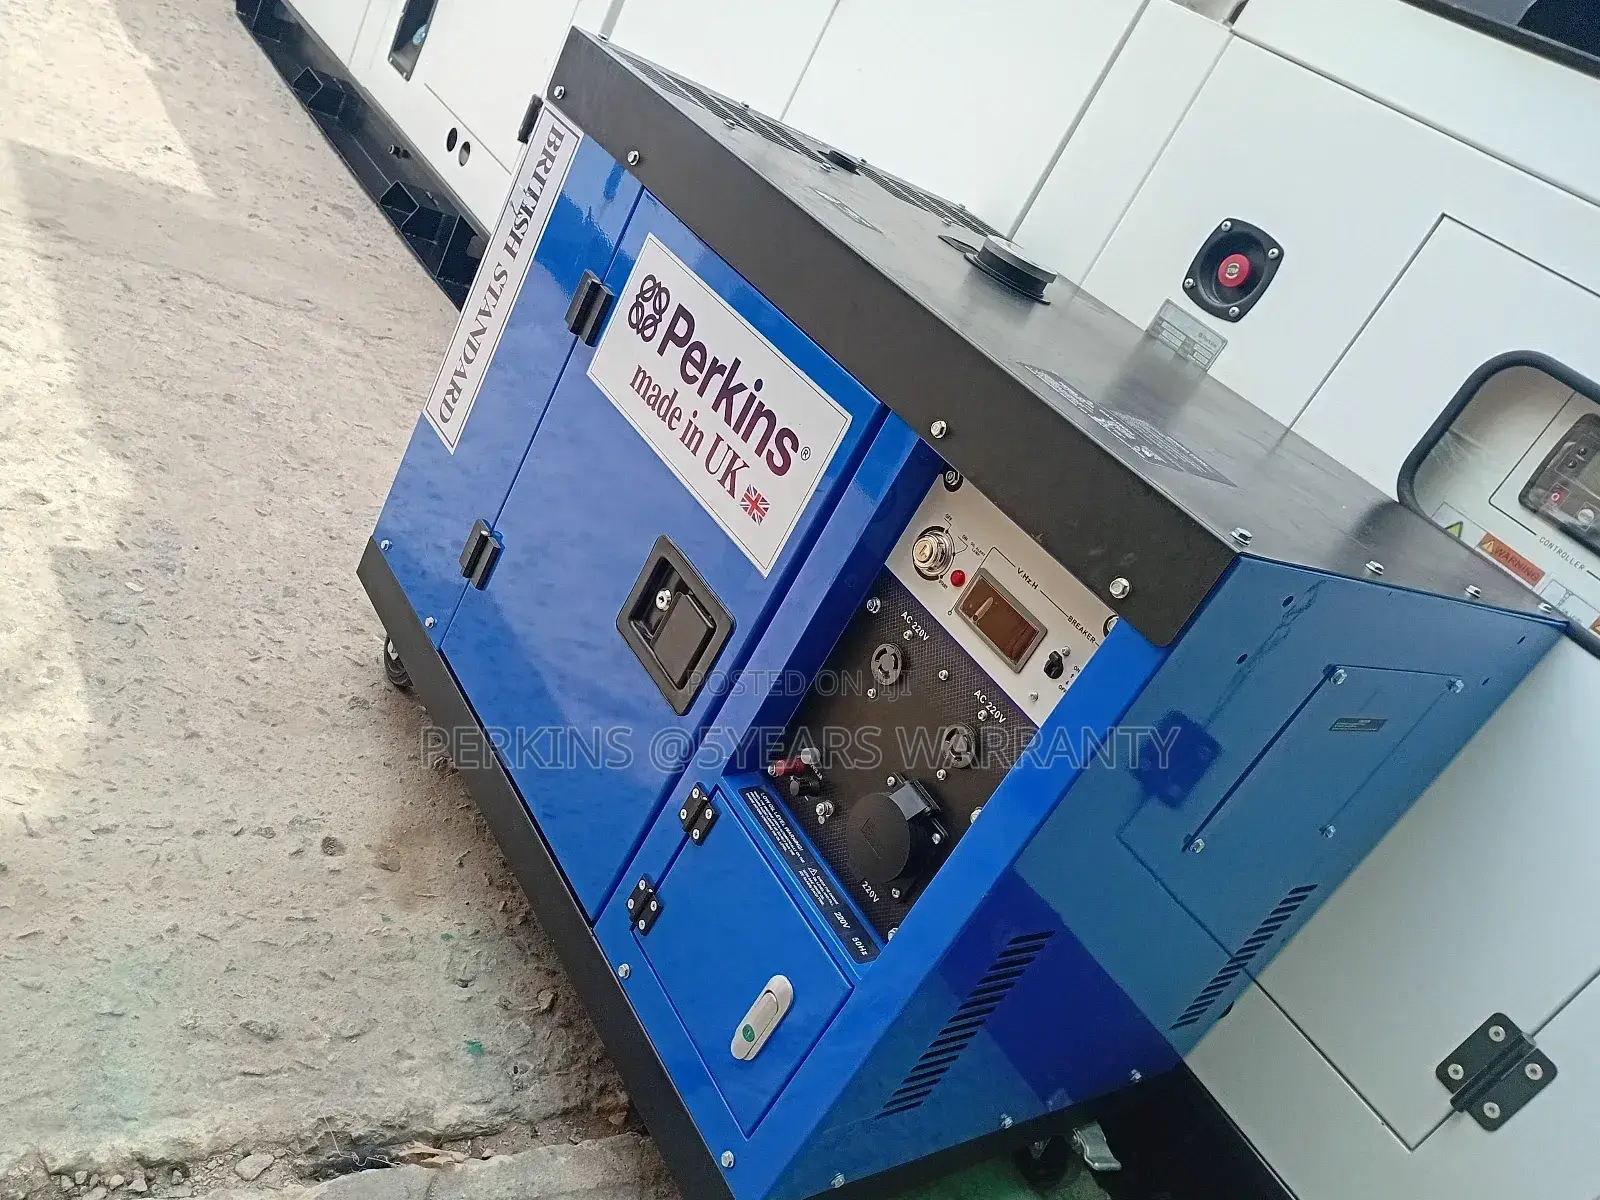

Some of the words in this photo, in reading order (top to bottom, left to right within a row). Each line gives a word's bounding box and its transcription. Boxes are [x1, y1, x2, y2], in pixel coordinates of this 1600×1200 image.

[502, 122, 567, 257] BRITISH
[438, 259, 510, 426] STANDARD
[629, 364, 682, 431] made
[678, 410, 704, 457] in
[703, 429, 753, 500] UK
[1494, 546, 1540, 582] WARNING
[1539, 536, 1586, 571] CONTROLLER
[900, 611, 913, 625] AC
[911, 622, 930, 642] 220V
[1067, 616, 1097, 644] BREAKER
[973, 689, 987, 704] AC
[985, 700, 1007, 724] 220V
[861, 881, 880, 903] 220V
[834, 911, 851, 929] 220V
[852, 937, 869, 956] 50Hz
